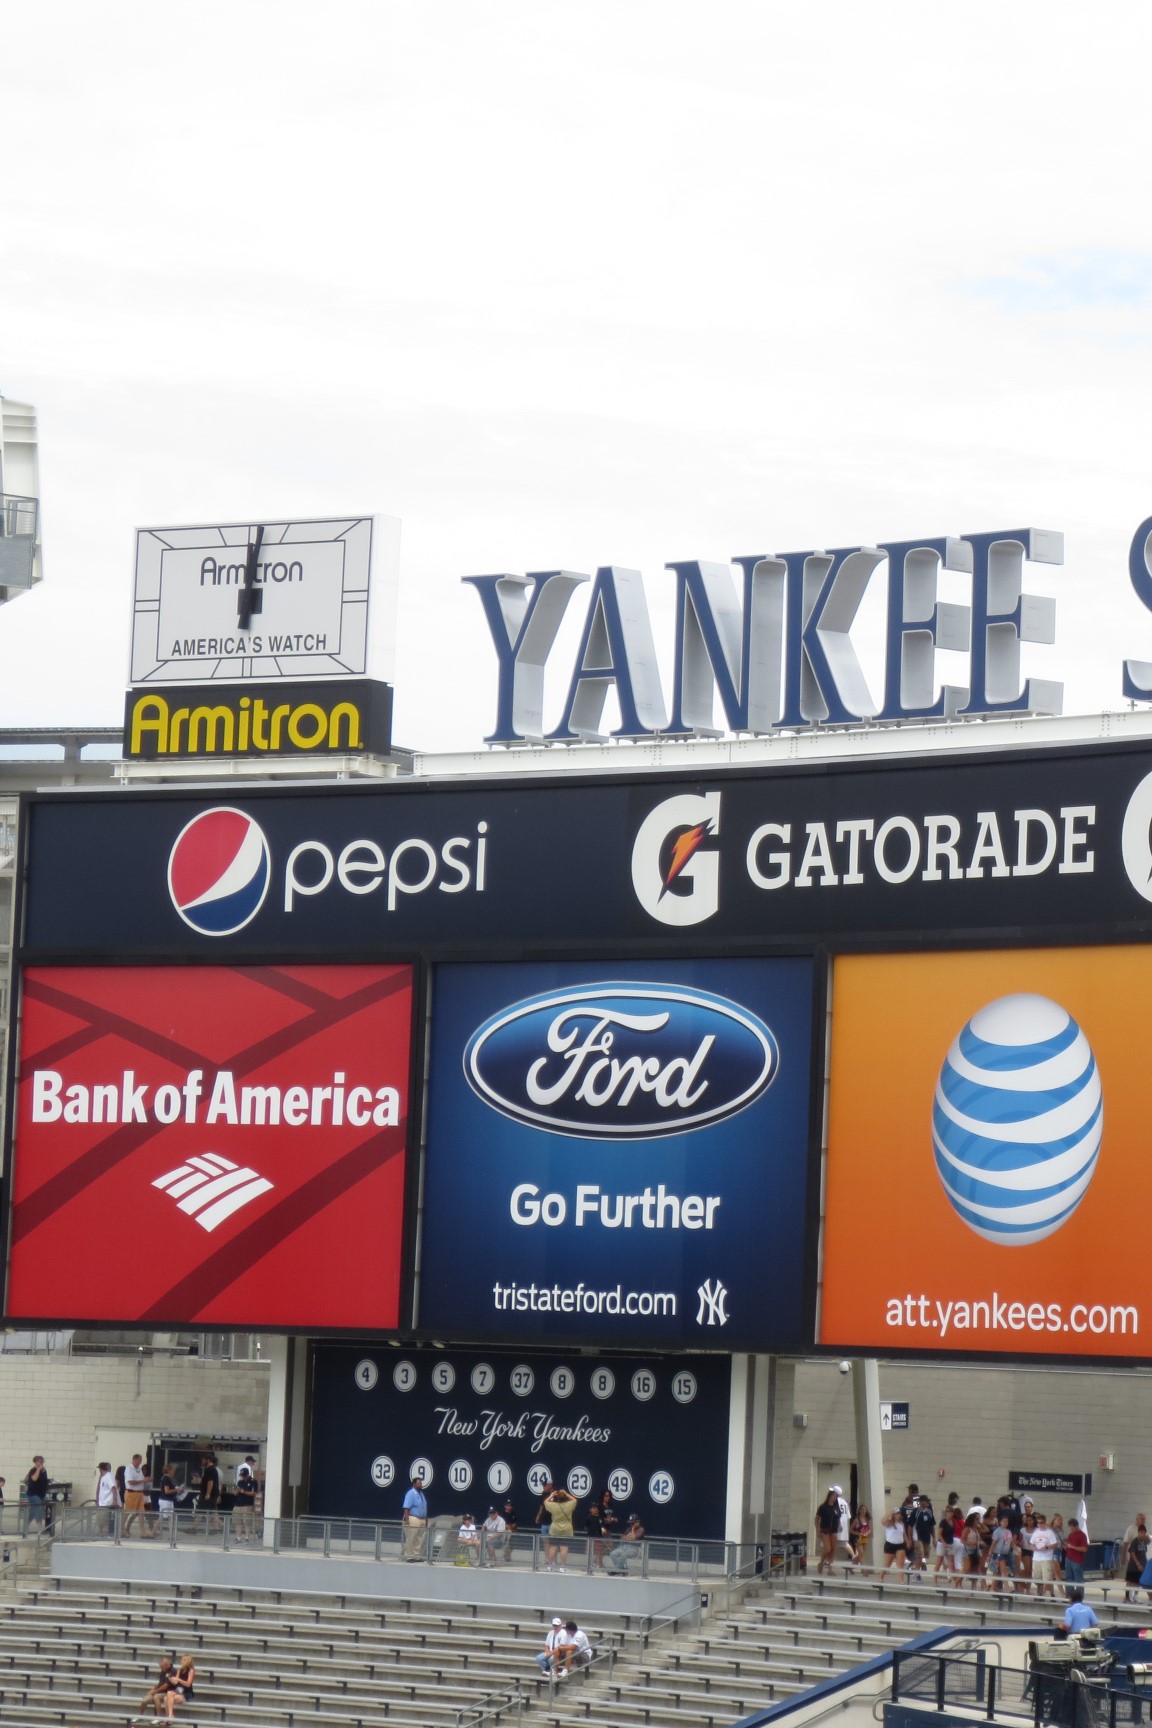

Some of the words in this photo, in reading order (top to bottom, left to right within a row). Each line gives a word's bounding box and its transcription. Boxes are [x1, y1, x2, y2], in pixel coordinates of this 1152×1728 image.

[200, 556, 303, 586] Armtron
[171, 635, 263, 656] AMERICA'S
[269, 633, 327, 653] WATCH
[460, 527, 1064, 745] YANKEE
[131, 694, 360, 754] Armitron
[284, 821, 487, 911] pepsi
[746, 805, 1097, 890] GATORADE
[526, 1007, 716, 1108] Ford
[32, 1070, 149, 1123] Bank
[154, 1069, 203, 1123] of
[206, 1071, 400, 1127] America
[510, 1183, 566, 1227] Go
[575, 1184, 721, 1230] Further
[493, 1281, 677, 1316] tristateford.com
[886, 1292, 1139, 1337] att.yankees.com
[361, 1367, 370, 1382] 4
[401, 1368, 409, 1384] 3
[440, 1370, 448, 1385] 5
[479, 1371, 487, 1386] 7
[514, 1372, 531, 1388] 37
[558, 1374, 566, 1390] 8
[598, 1375, 607, 1391] 8
[636, 1377, 650, 1393] 16
[677, 1379, 691, 1395] 15
[434, 1408, 479, 1436] New
[479, 1410, 529, 1450] York
[530, 1413, 611, 1453] Yankees
[375, 1463, 391, 1479] 32
[454, 1467, 467, 1483] 10
[571, 1474, 588, 1490] 23
[611, 1476, 628, 1492] 49
[653, 1479, 669, 1495] 42
[1018, 1476, 1029, 1486] The
[1029, 1477, 1042, 1486] New
[1042, 1477, 1055, 1488] York
[1055, 1478, 1074, 1488] Times
